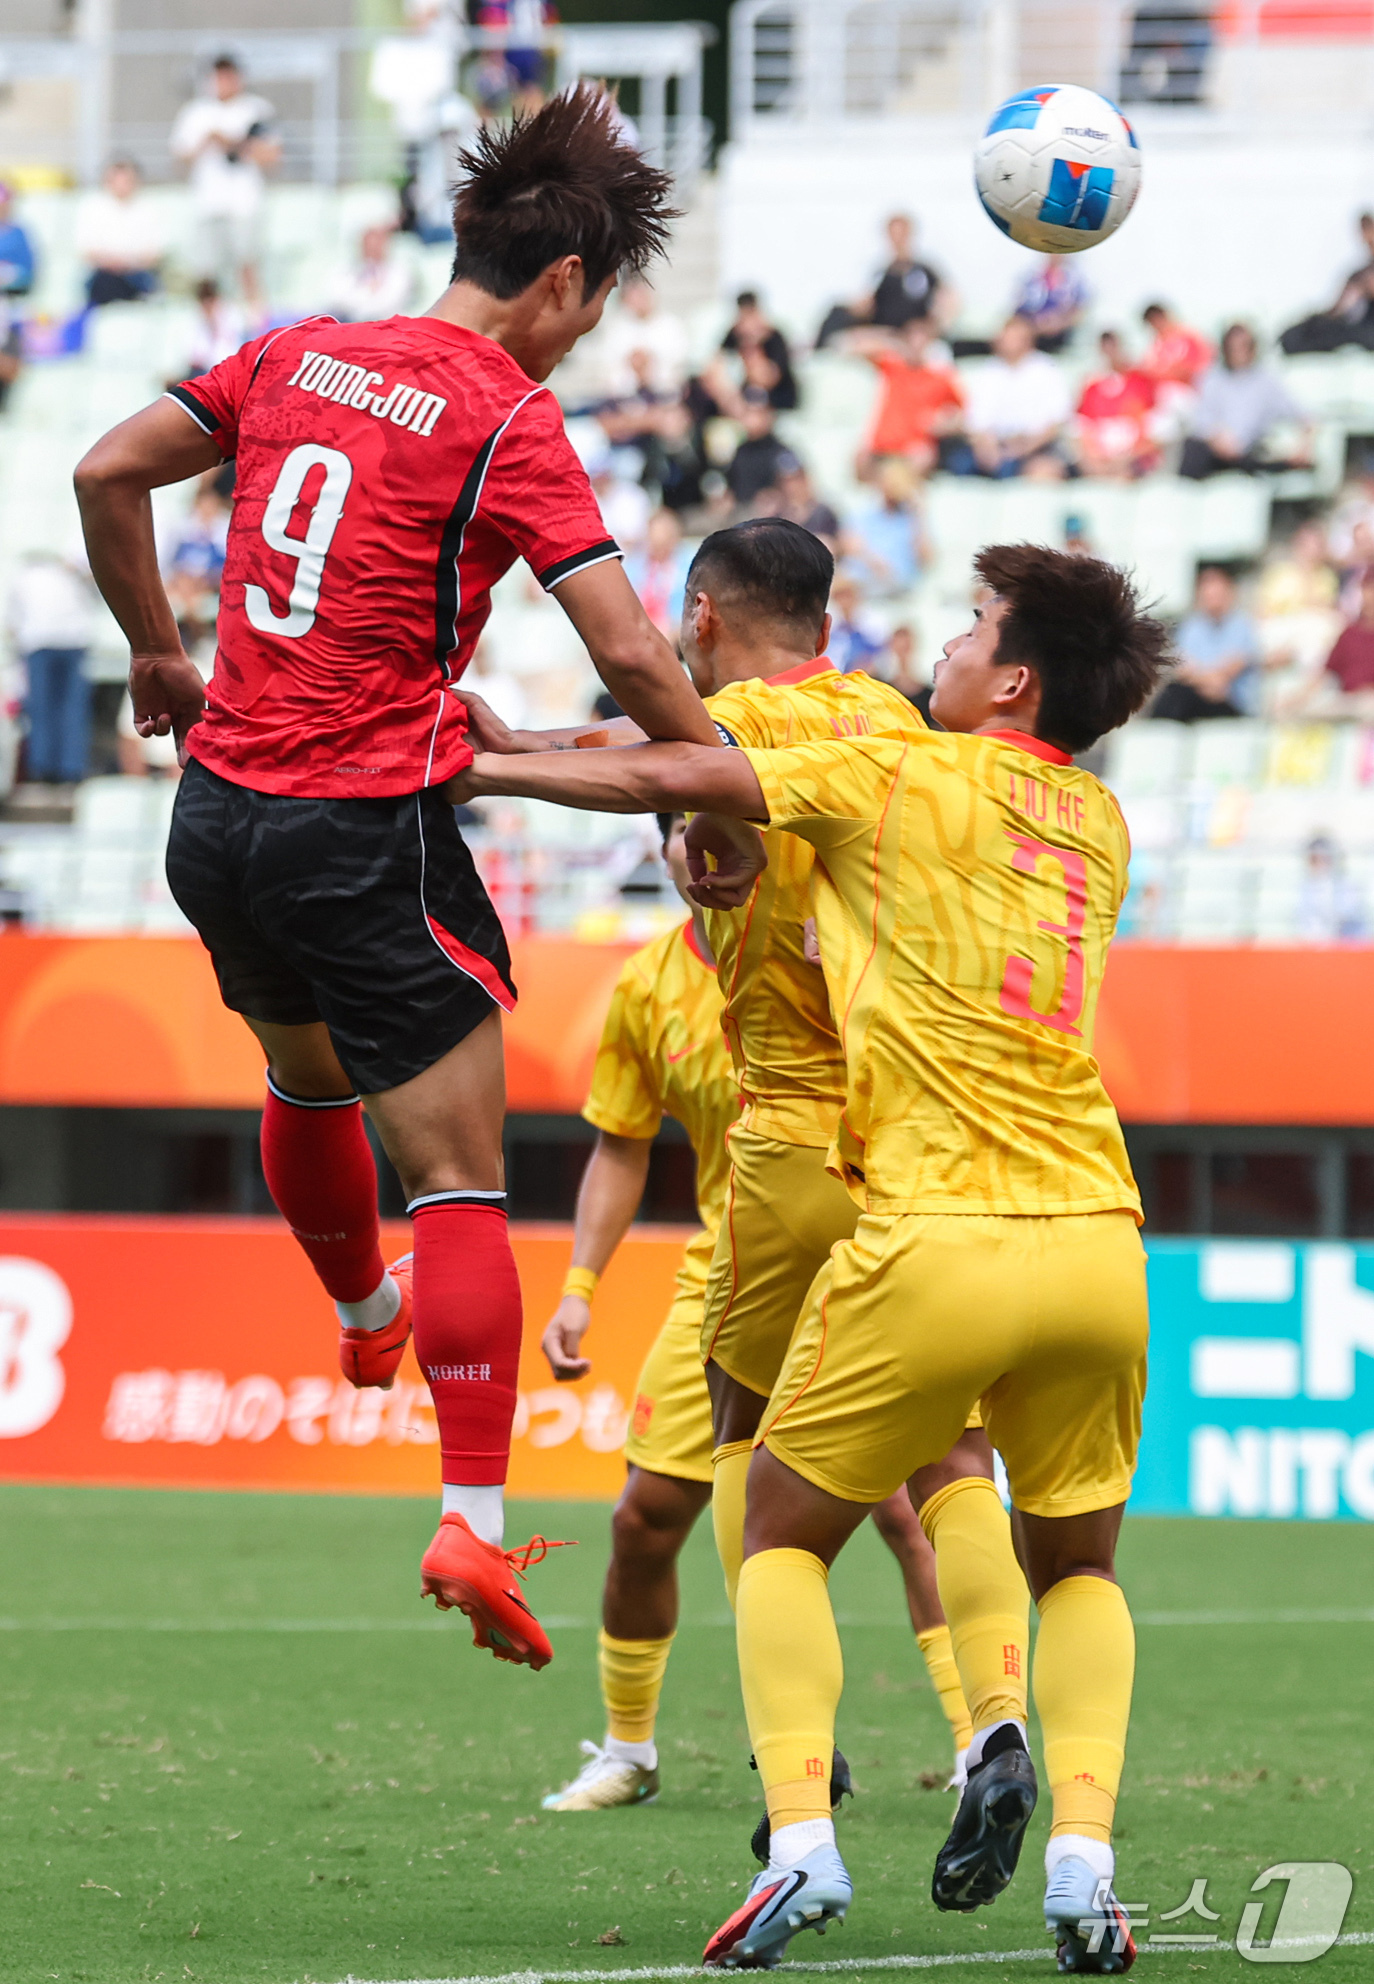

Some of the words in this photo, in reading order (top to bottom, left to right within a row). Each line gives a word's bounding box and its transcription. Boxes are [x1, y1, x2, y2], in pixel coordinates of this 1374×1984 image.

[1061, 126, 1112, 142] molten
[286, 350, 448, 437] YOUNGJUN
[242, 443, 353, 638] 9
[1009, 773, 1048, 822] LIU
[999, 830, 1088, 1037] 3
